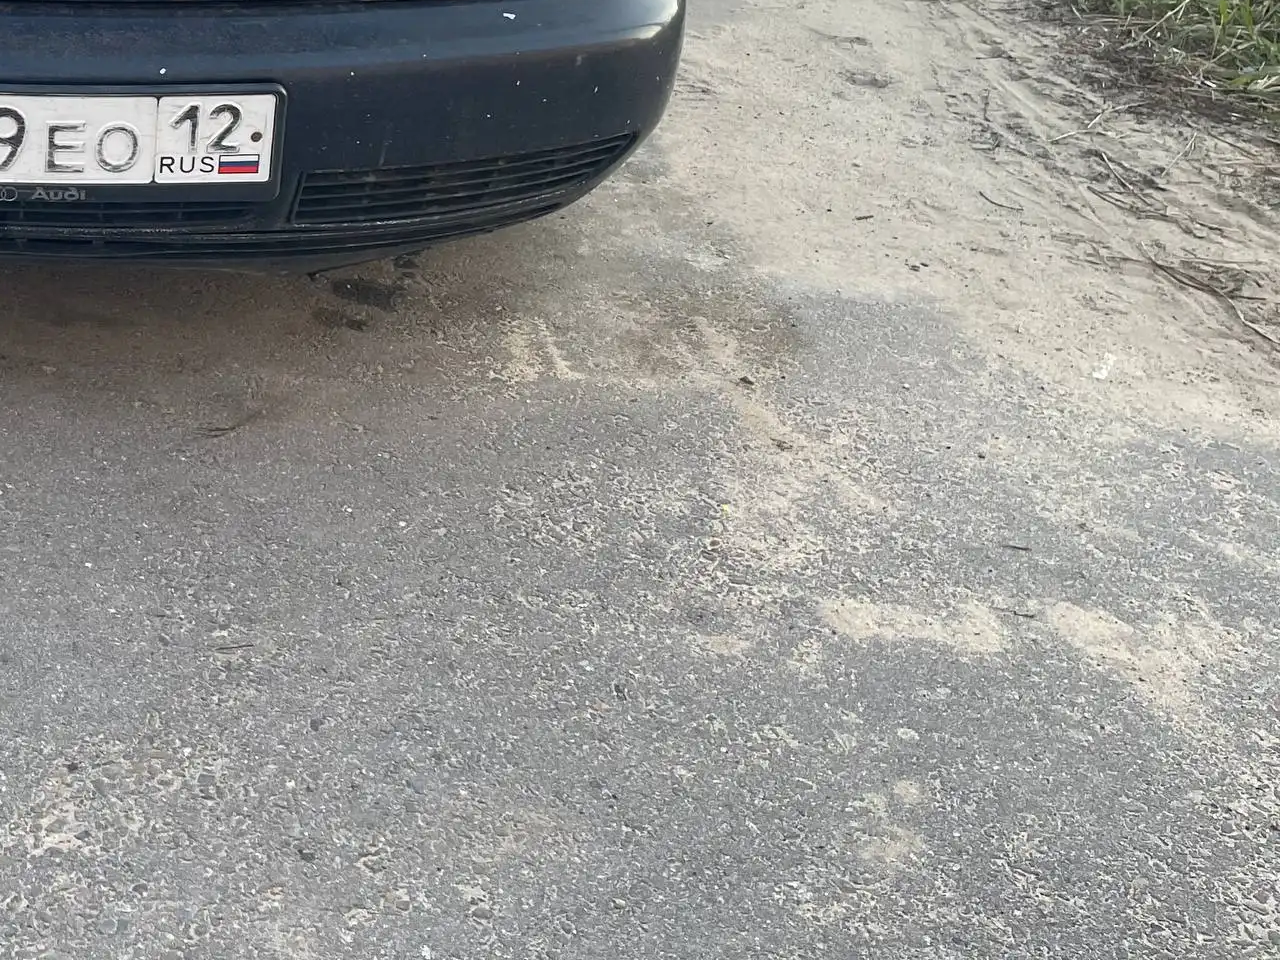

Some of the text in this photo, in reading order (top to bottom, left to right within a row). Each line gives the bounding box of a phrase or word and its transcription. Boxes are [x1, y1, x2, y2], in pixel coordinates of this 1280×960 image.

[169, 102, 242, 153] 12
[158, 155, 215, 174] RUS
[31, 187, 87, 201] Audi
